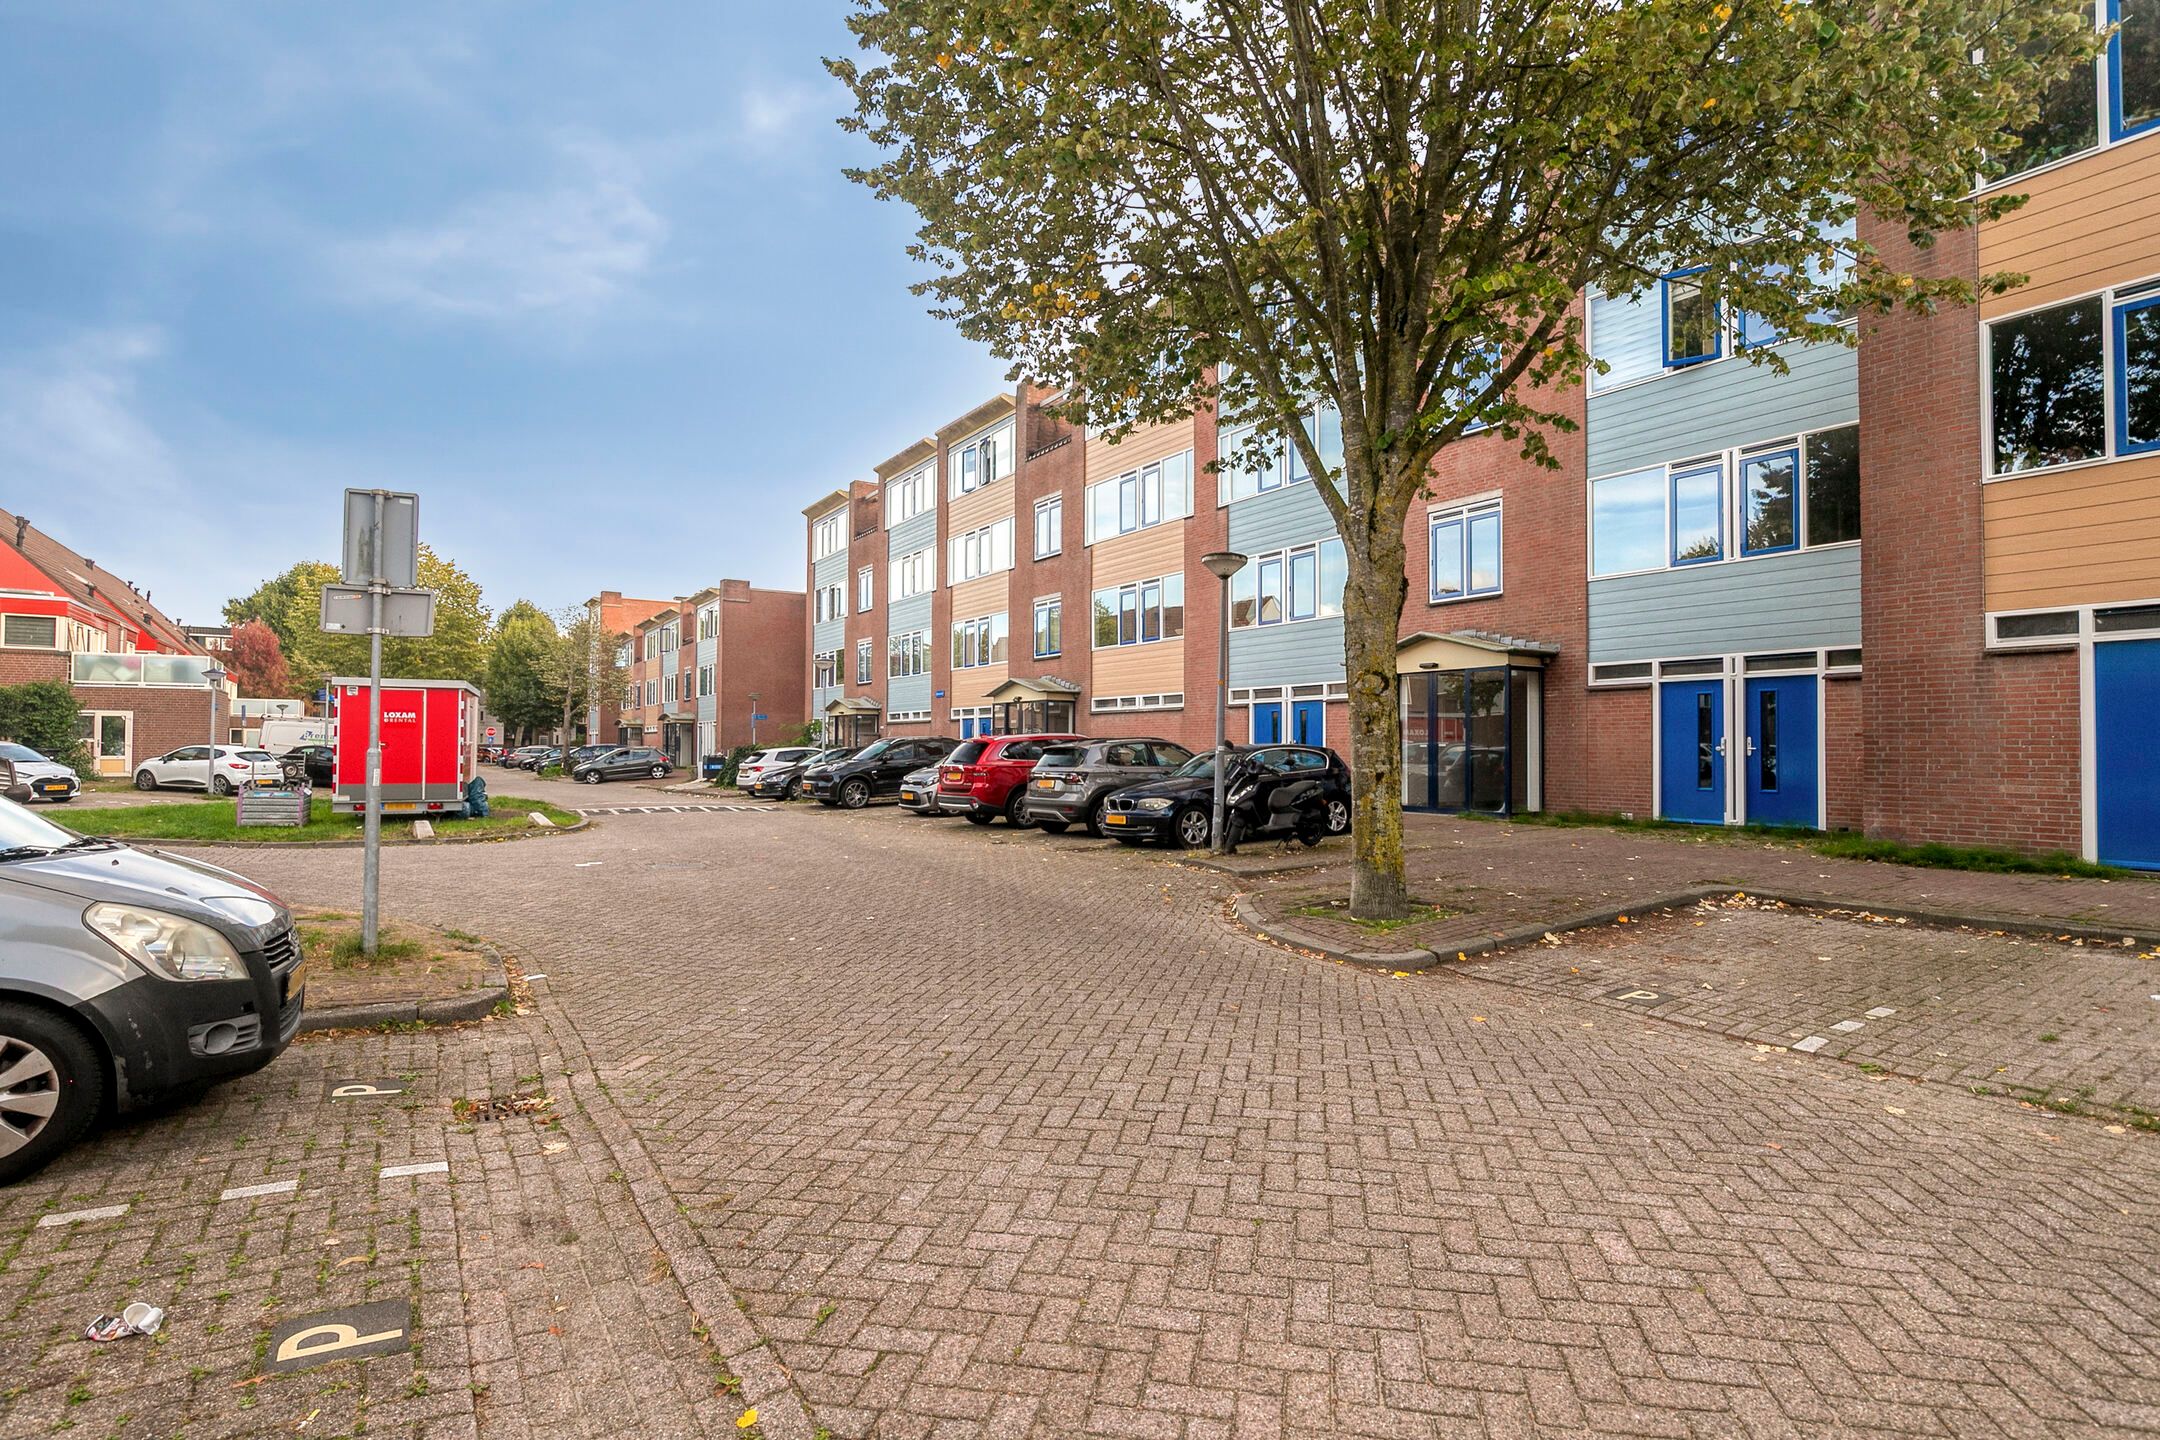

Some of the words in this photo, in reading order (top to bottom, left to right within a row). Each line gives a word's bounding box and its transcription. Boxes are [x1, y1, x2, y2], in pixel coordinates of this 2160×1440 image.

[384, 711, 416, 719] LOXAM
[1616, 990, 1659, 1000] P
[332, 1085, 402, 1097] P
[276, 1324, 403, 1361] P
